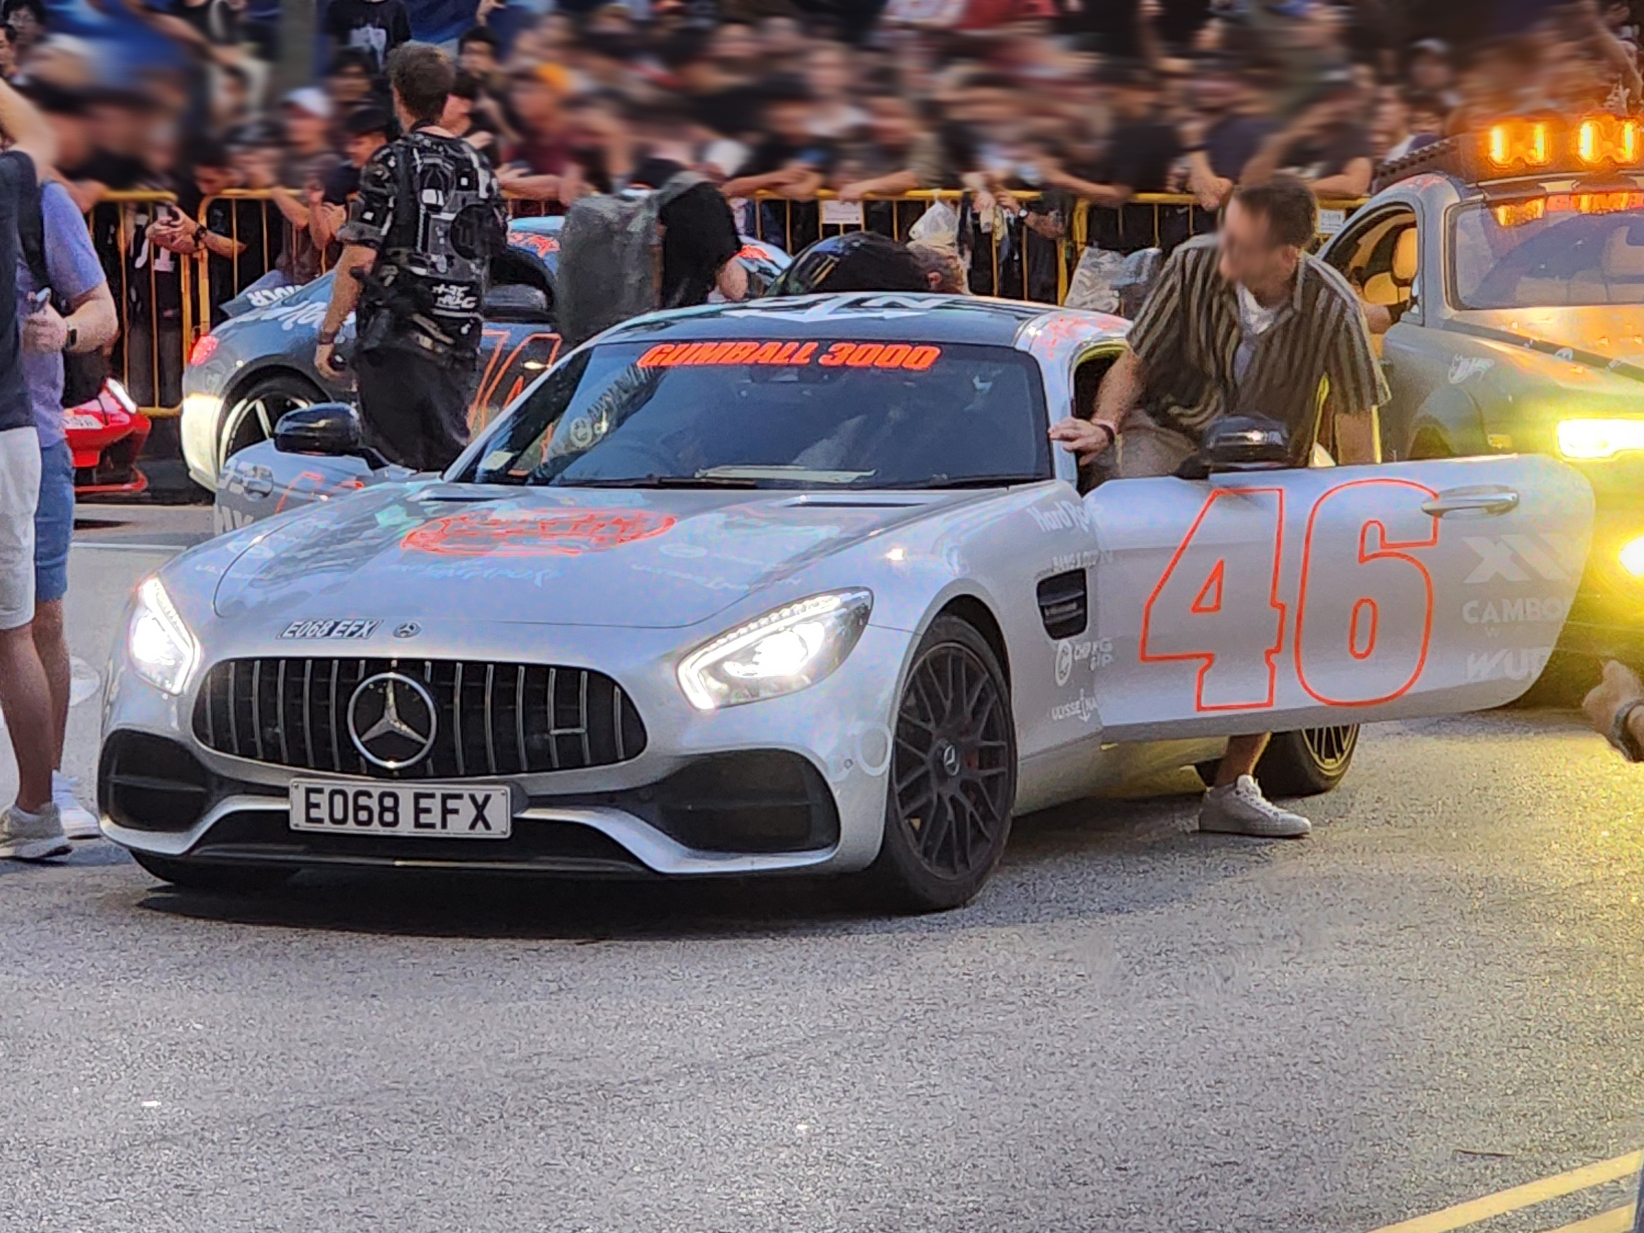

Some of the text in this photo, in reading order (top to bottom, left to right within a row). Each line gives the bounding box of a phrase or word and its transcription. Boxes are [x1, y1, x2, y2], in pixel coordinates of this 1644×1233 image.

[636, 341, 941, 370] GUMBALL 3000
[1026, 501, 1073, 533] Hard
[1139, 478, 1440, 712] 46
[329, 619, 379, 639] EFX
[413, 791, 493, 832] EFX
